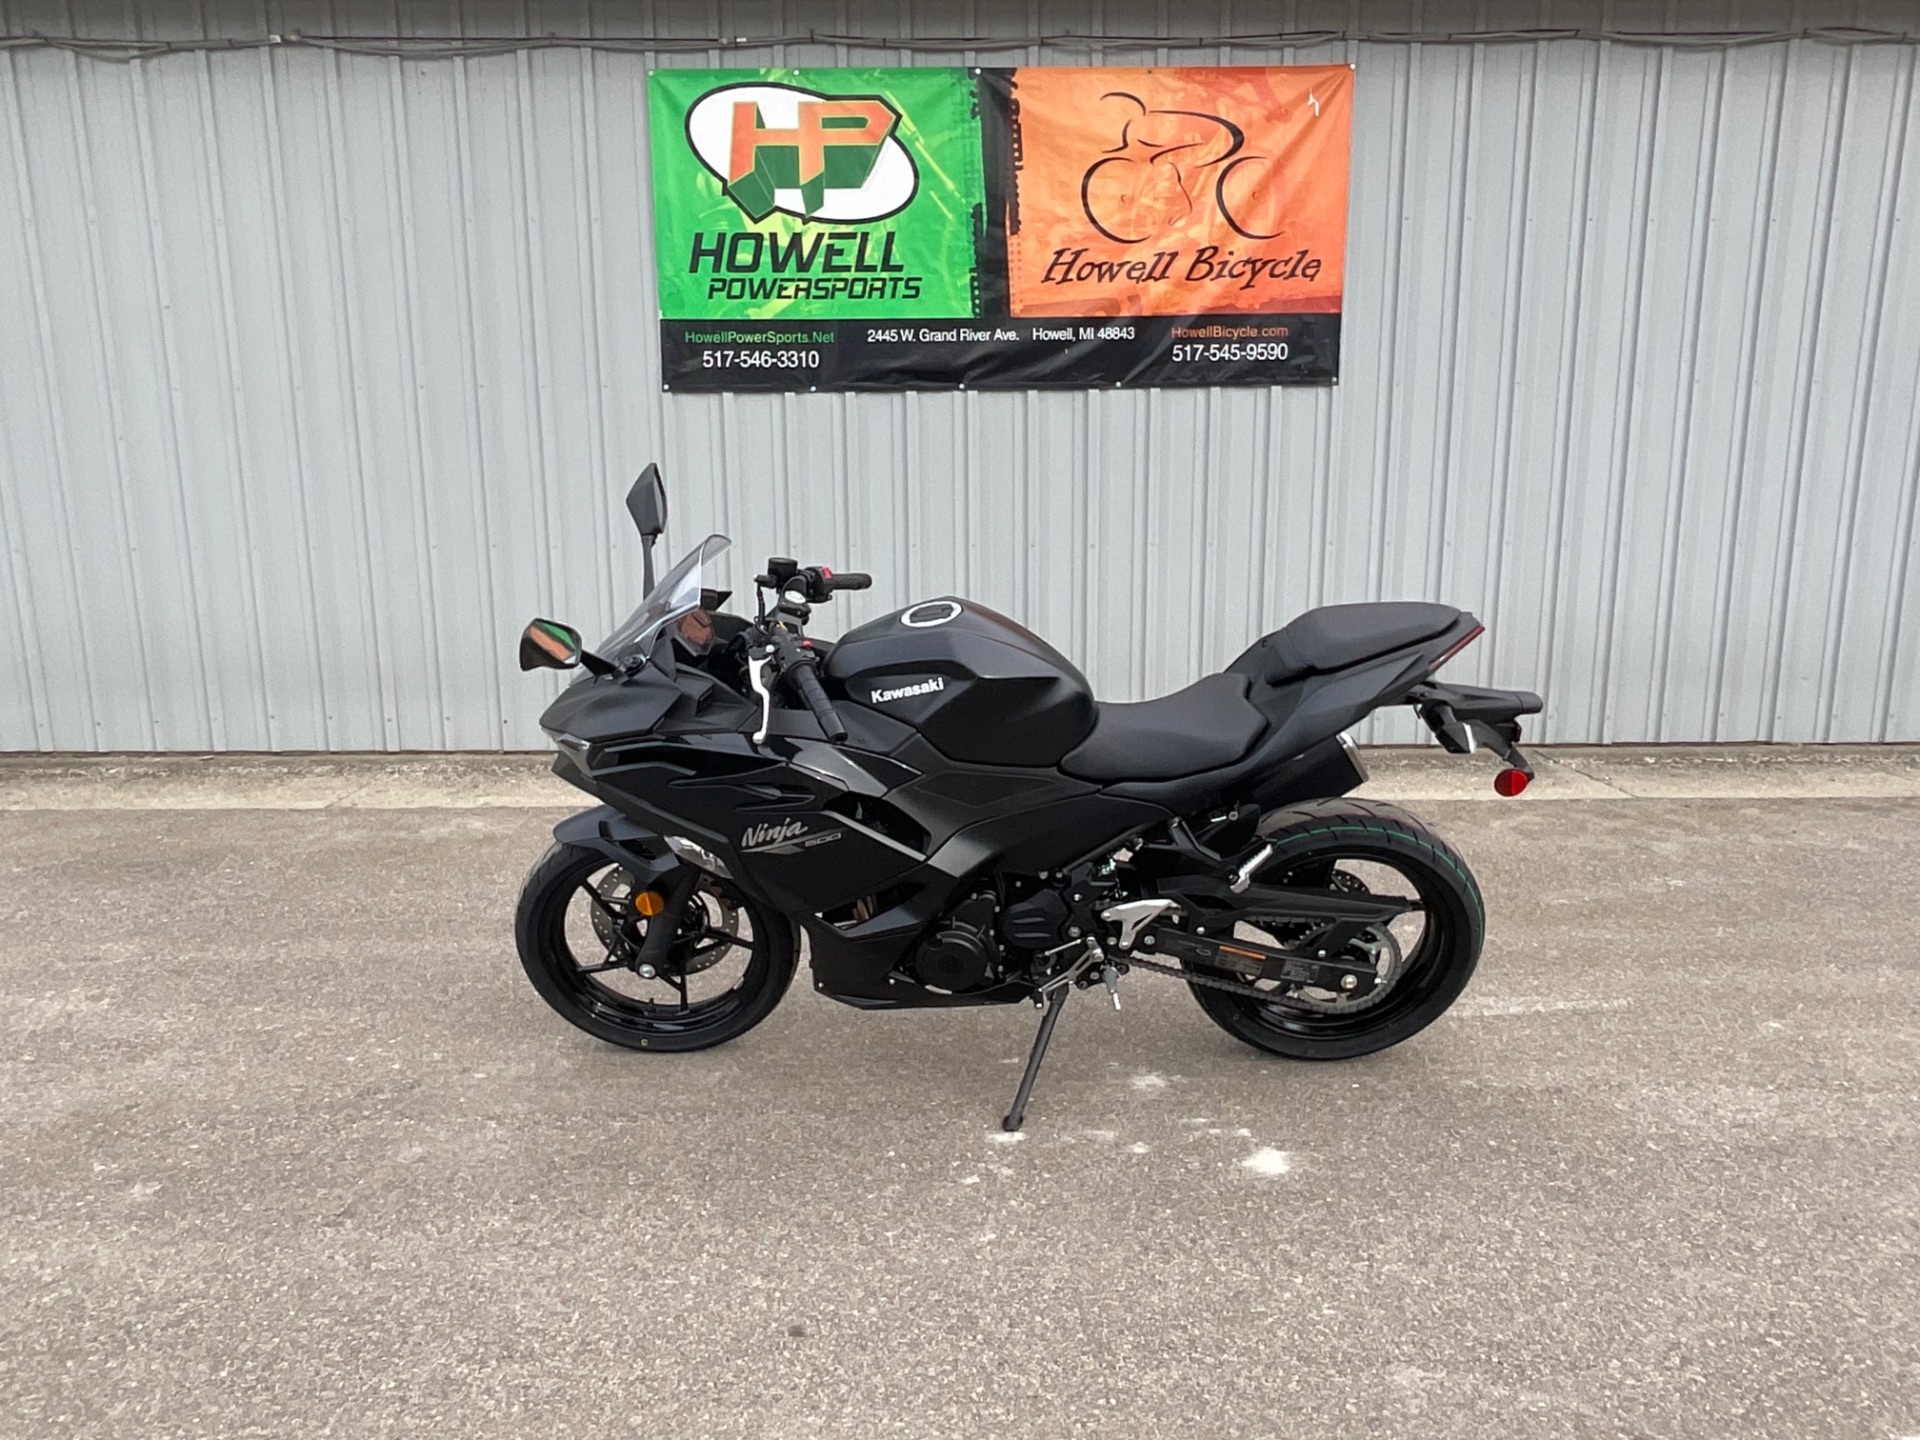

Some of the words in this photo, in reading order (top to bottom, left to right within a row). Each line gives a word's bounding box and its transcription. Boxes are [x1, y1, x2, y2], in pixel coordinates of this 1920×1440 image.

[729, 101, 897, 188] HP
[689, 231, 905, 274] HOWELL
[1041, 247, 1178, 285] Howell
[1185, 245, 1322, 290] Bicycle
[708, 277, 923, 300] POWERSPORTS
[684, 331, 835, 345] HowellPowerSports.Net
[867, 329, 898, 342] 2445
[900, 329, 916, 342] W.
[919, 328, 957, 342] Grand
[960, 328, 991, 341] River
[994, 328, 1019, 341] Ave.
[1032, 327, 1076, 342] Howell,
[1079, 327, 1094, 341] MI
[1097, 326, 1135, 340] 48843
[1171, 325, 1289, 340] HowellBicycle.com
[702, 350, 820, 368] 517-546-3310
[1172, 343, 1289, 362] 517-545-9590
[871, 677, 945, 704] Kawasaki
[741, 817, 809, 847] Ninja
